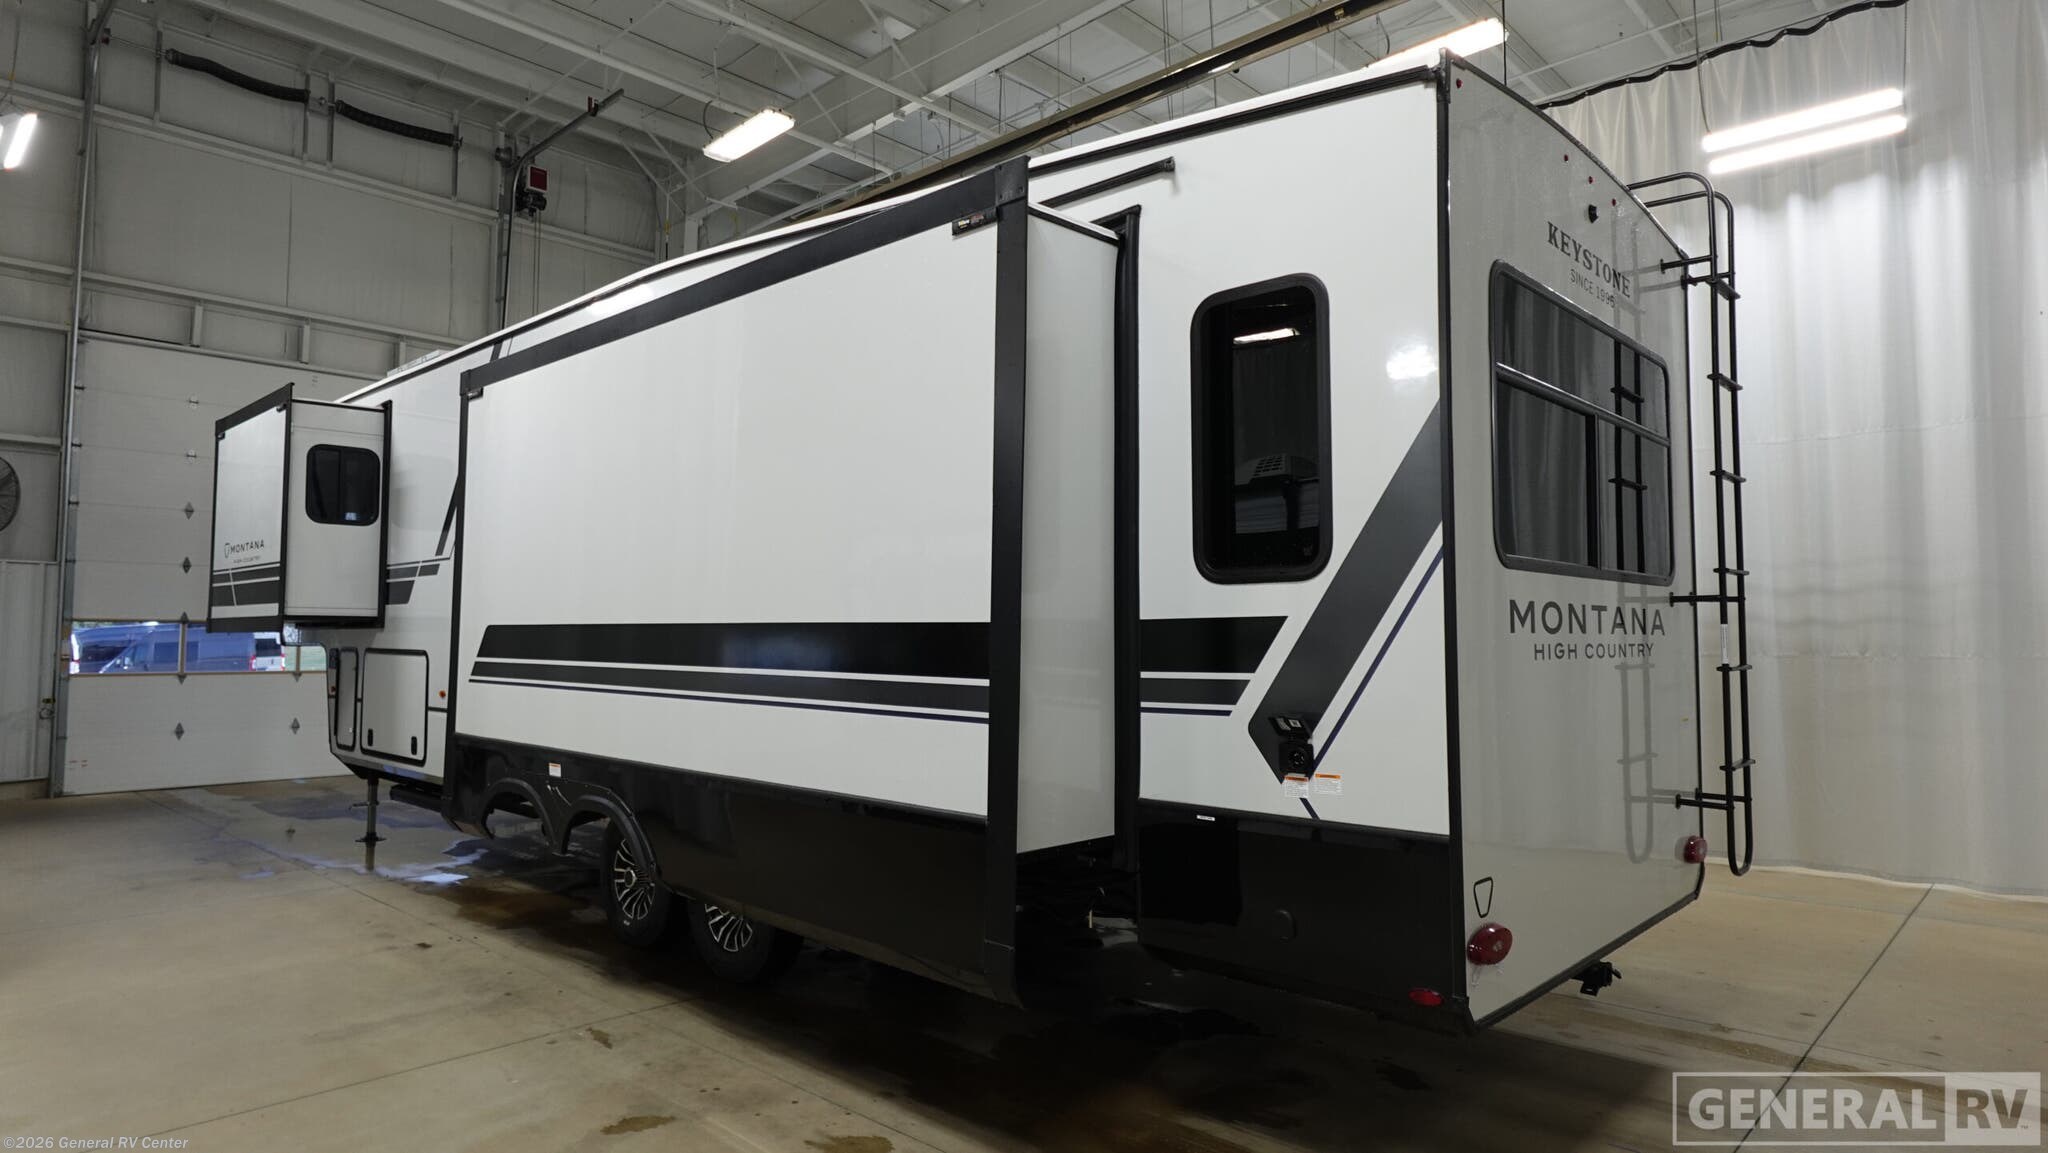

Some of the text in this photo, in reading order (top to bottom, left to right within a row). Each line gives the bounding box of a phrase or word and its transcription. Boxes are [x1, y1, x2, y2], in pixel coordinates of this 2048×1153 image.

[1548, 222, 1630, 298] KEYSTONE
[1570, 268, 1593, 295] SINCE
[230, 539, 265, 554] MONTANA
[1509, 599, 1665, 636] MONTANA
[1534, 642, 1654, 661] HIGH COUNTRY
